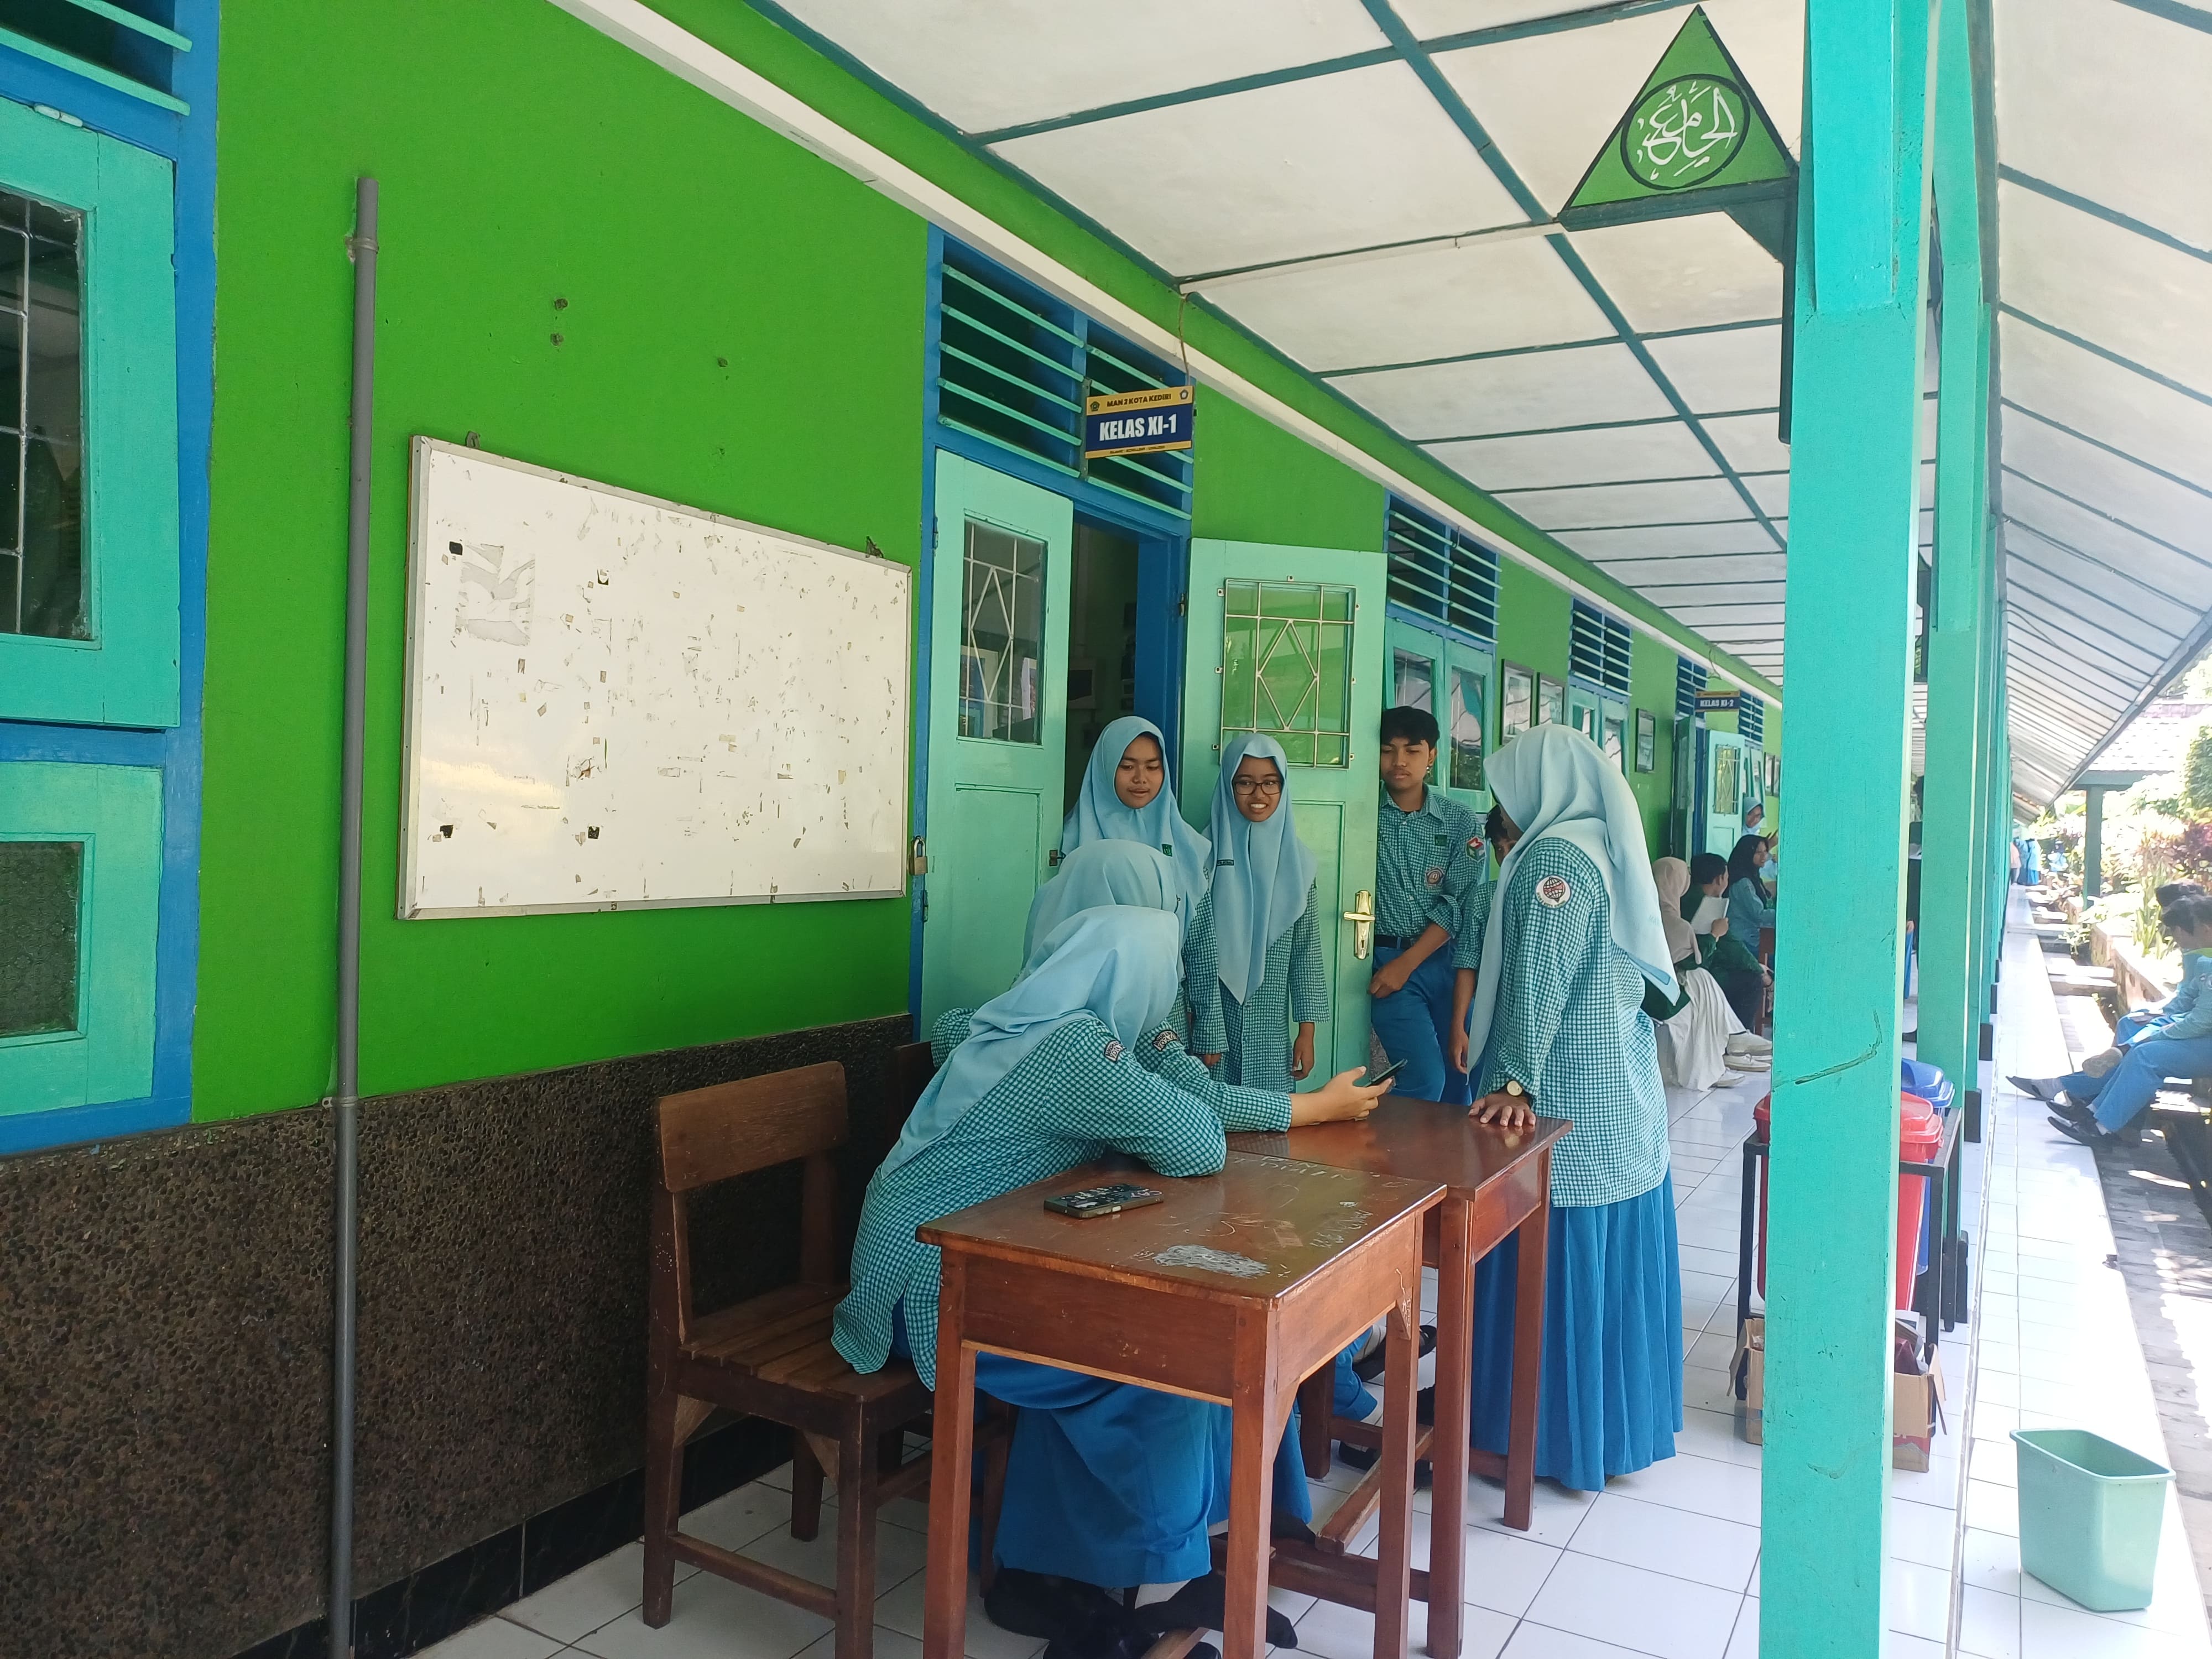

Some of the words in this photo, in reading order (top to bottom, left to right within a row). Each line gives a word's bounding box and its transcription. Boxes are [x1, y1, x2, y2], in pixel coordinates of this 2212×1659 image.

[1107, 399, 1123, 407] MAN
[1129, 396, 1148, 404] KOTA
[1149, 393, 1171, 402] KEDIRI
[1099, 418, 1145, 441] KELAS
[1147, 414, 1177, 436] XI-1
